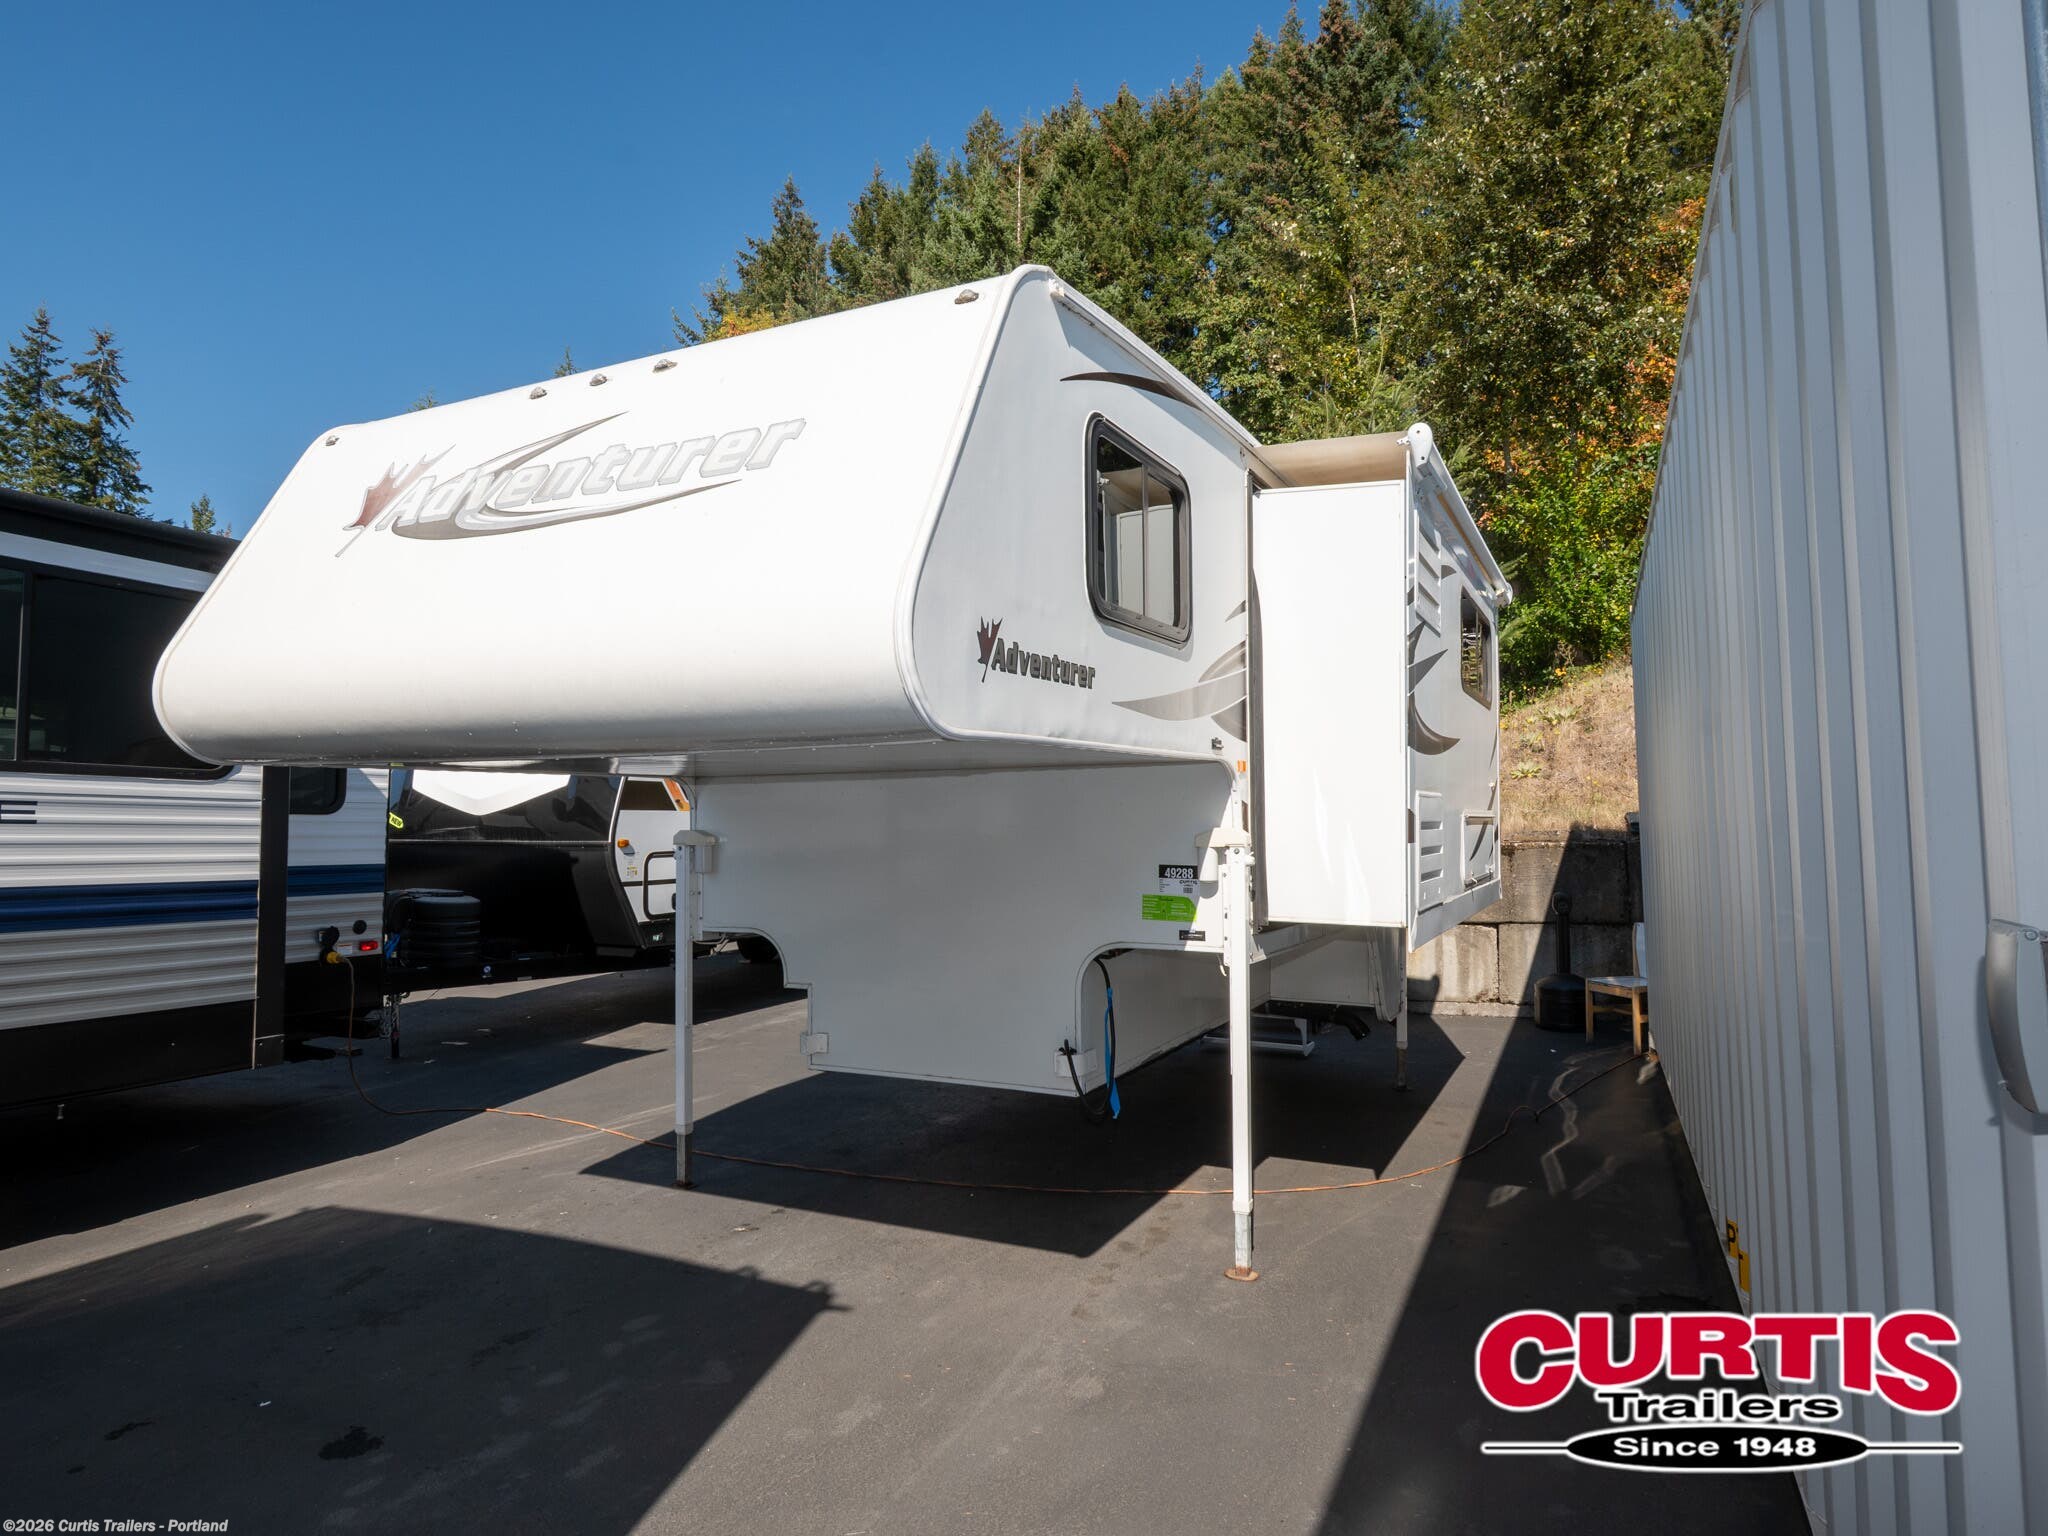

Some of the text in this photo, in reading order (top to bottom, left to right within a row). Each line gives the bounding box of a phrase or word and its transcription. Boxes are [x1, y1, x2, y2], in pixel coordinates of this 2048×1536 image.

[375, 418, 807, 531] Adventurer
[990, 637, 1096, 689] Adventurer
[1164, 867, 1194, 880] 49288
